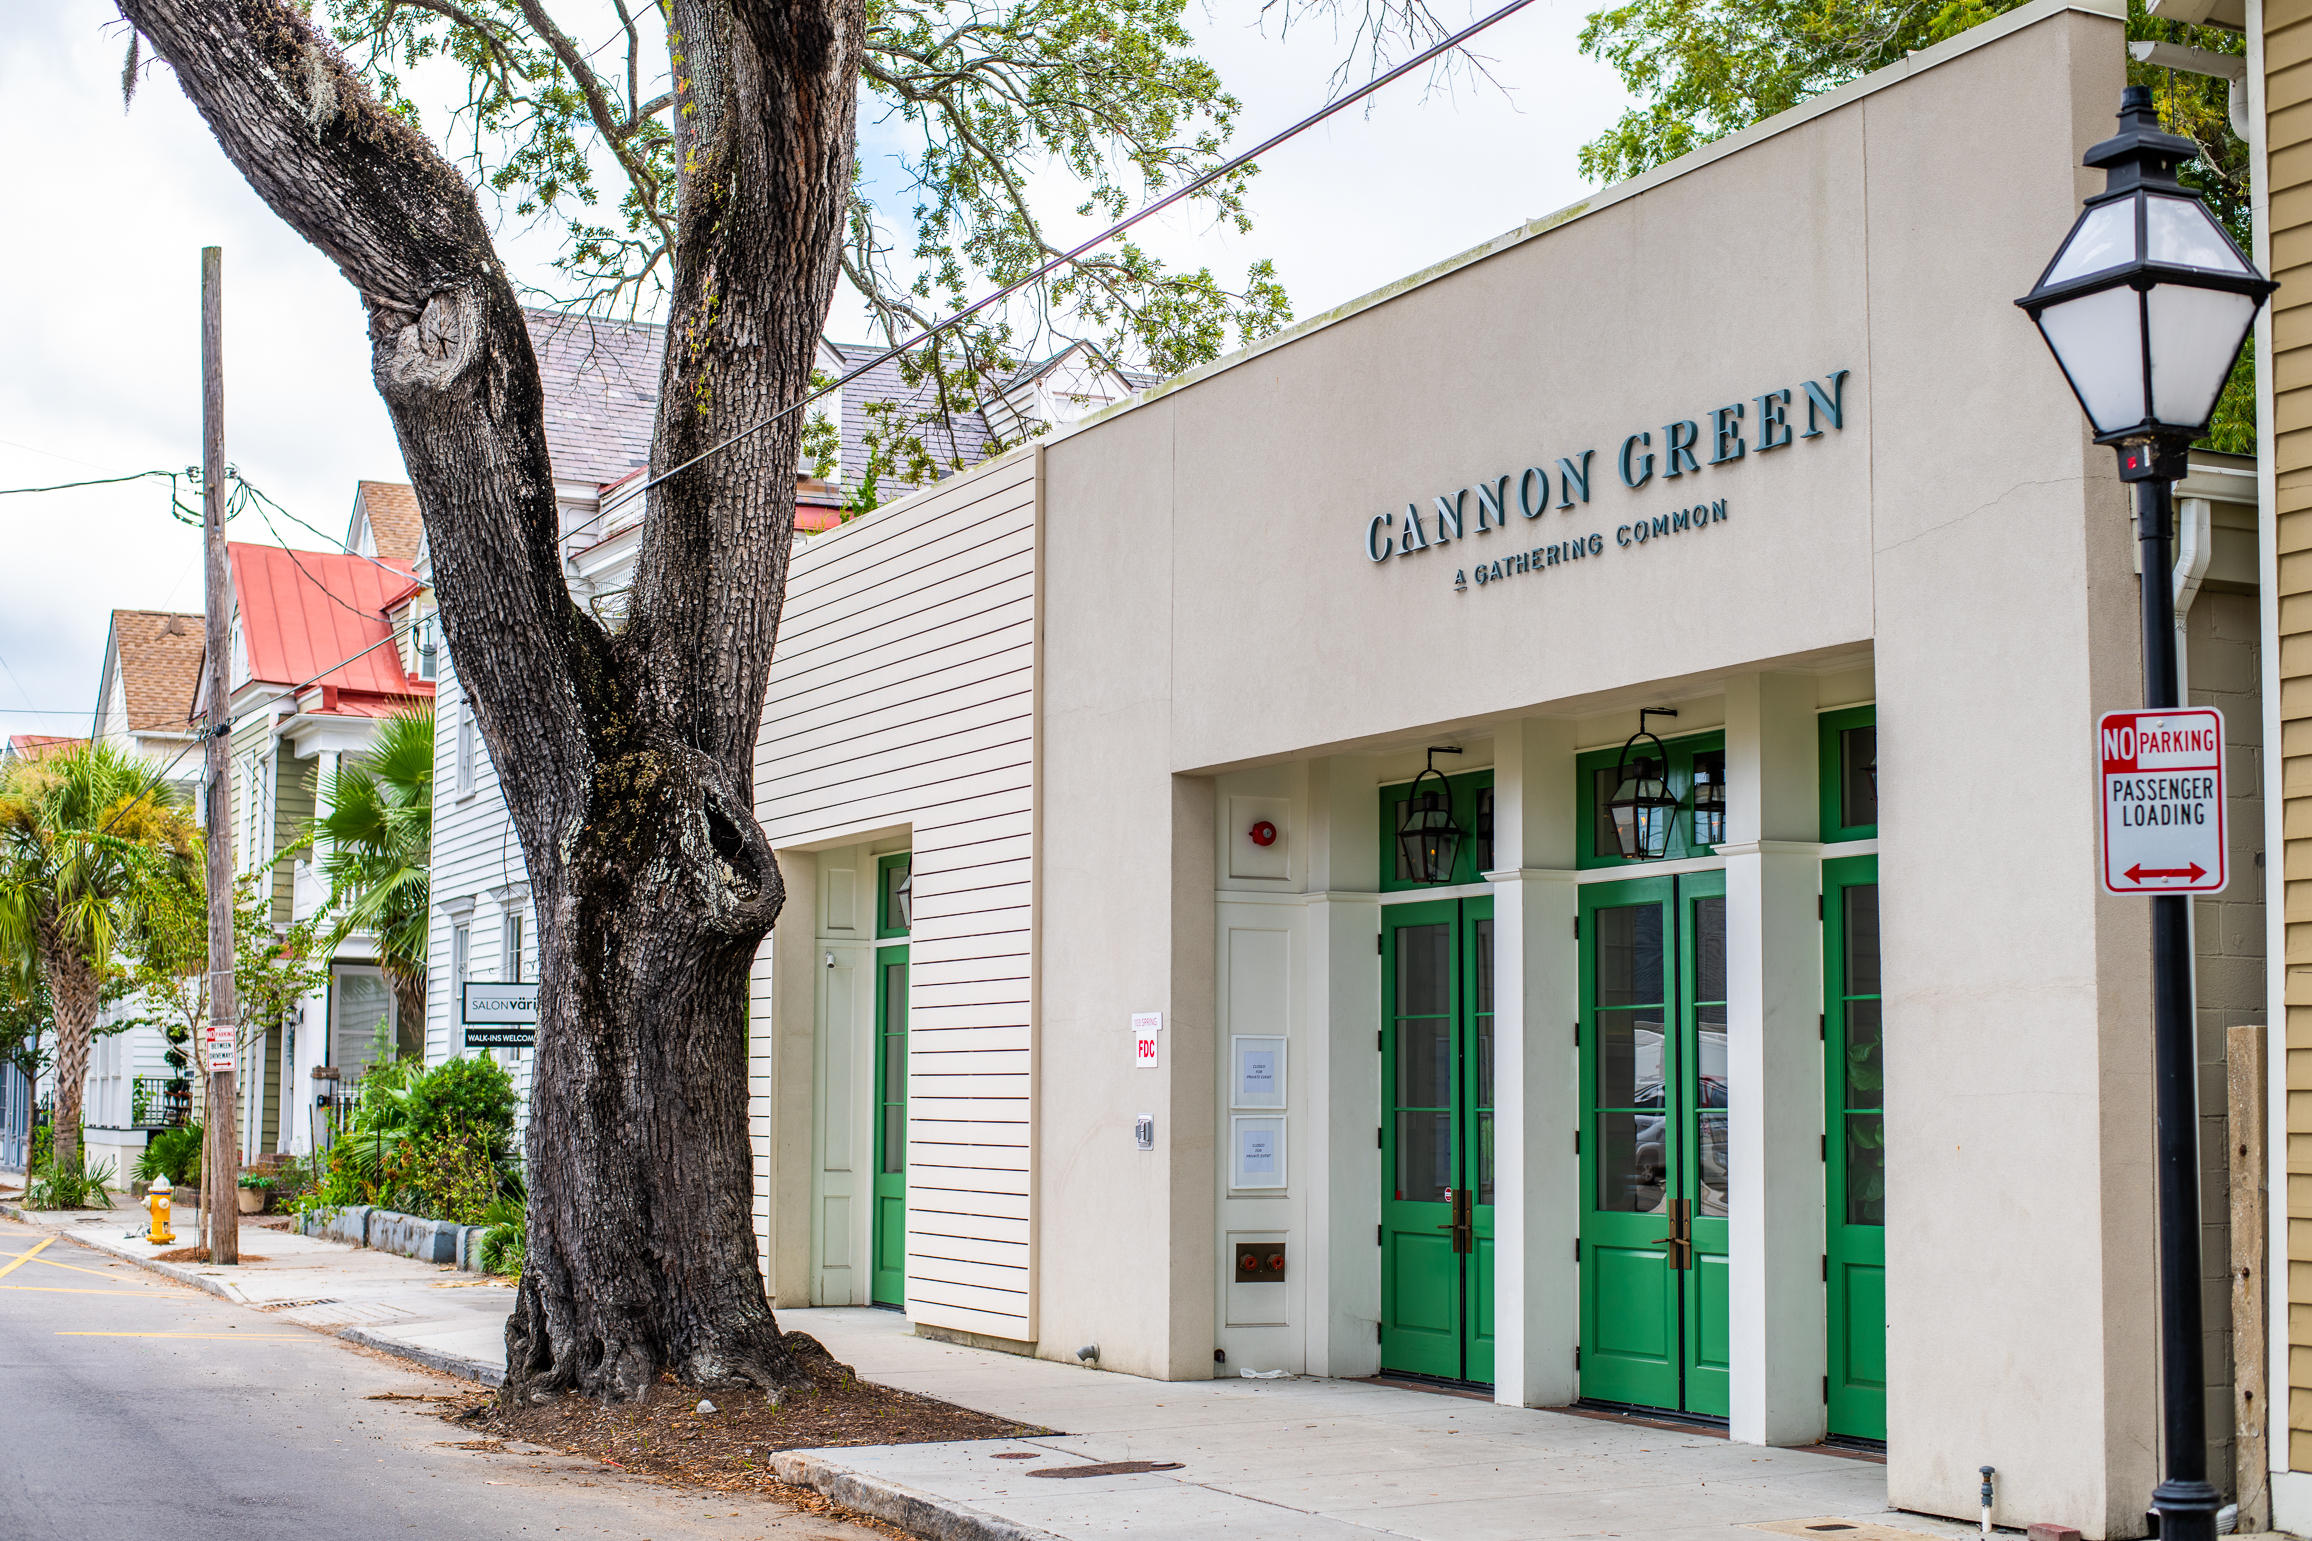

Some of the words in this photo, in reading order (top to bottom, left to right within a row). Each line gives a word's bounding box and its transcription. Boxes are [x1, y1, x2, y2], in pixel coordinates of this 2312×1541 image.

[1364, 449, 1597, 563] CANNON
[1617, 368, 1852, 489] GREEN
[1454, 568, 1467, 590] A
[1474, 532, 1604, 586] GATHERING
[1616, 498, 1729, 548] COMMON
[2103, 726, 2136, 761] NO
[2140, 729, 2214, 754] PARKING
[2113, 778, 2213, 802] PASSENGER
[2123, 803, 2205, 827] LOADING
[207, 1030, 215, 1039] NO
[467, 1034, 501, 1042] WALK-INS
[503, 1034, 535, 1042] WELCOM
[1138, 1039, 1155, 1058] FDC
